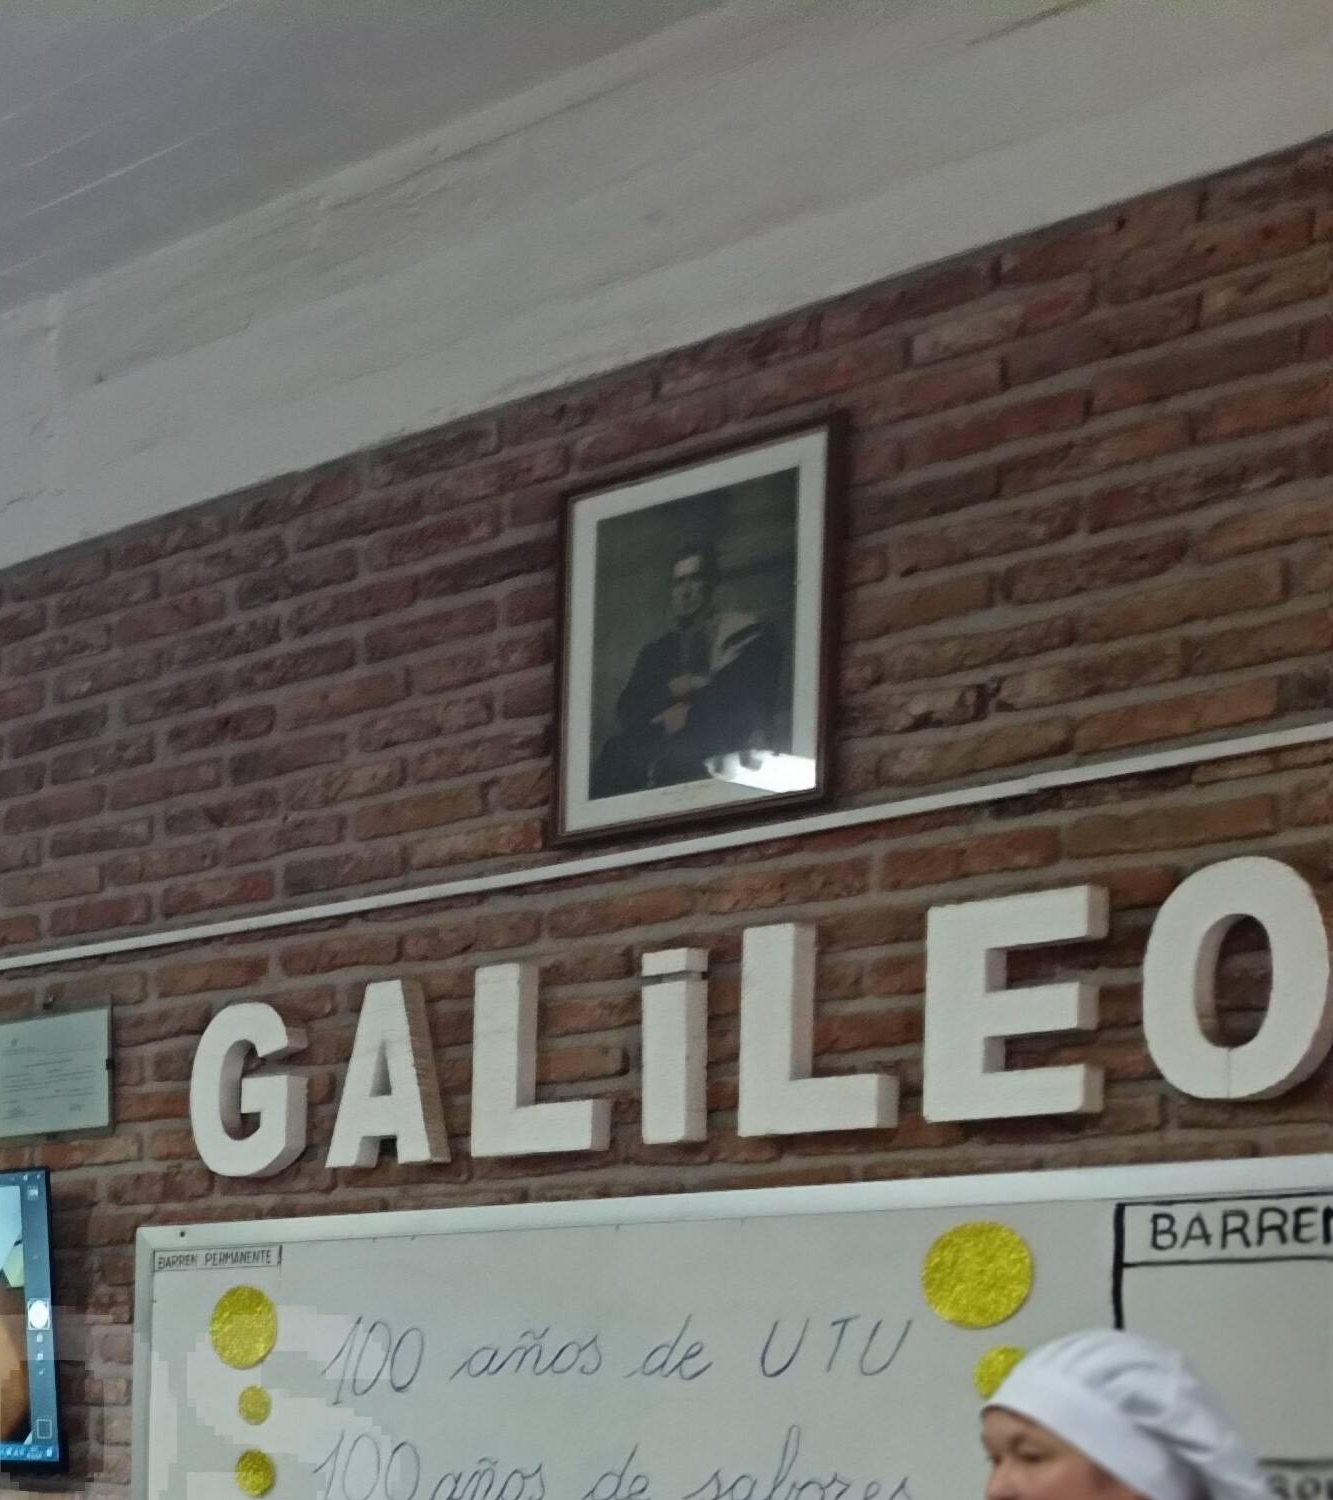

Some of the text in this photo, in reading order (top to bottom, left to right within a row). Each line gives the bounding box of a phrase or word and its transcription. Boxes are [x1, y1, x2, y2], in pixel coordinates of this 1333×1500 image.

[204, 1249, 273, 1267] PERMANENTE
[321, 1313, 914, 1406] 100 años de UTU
